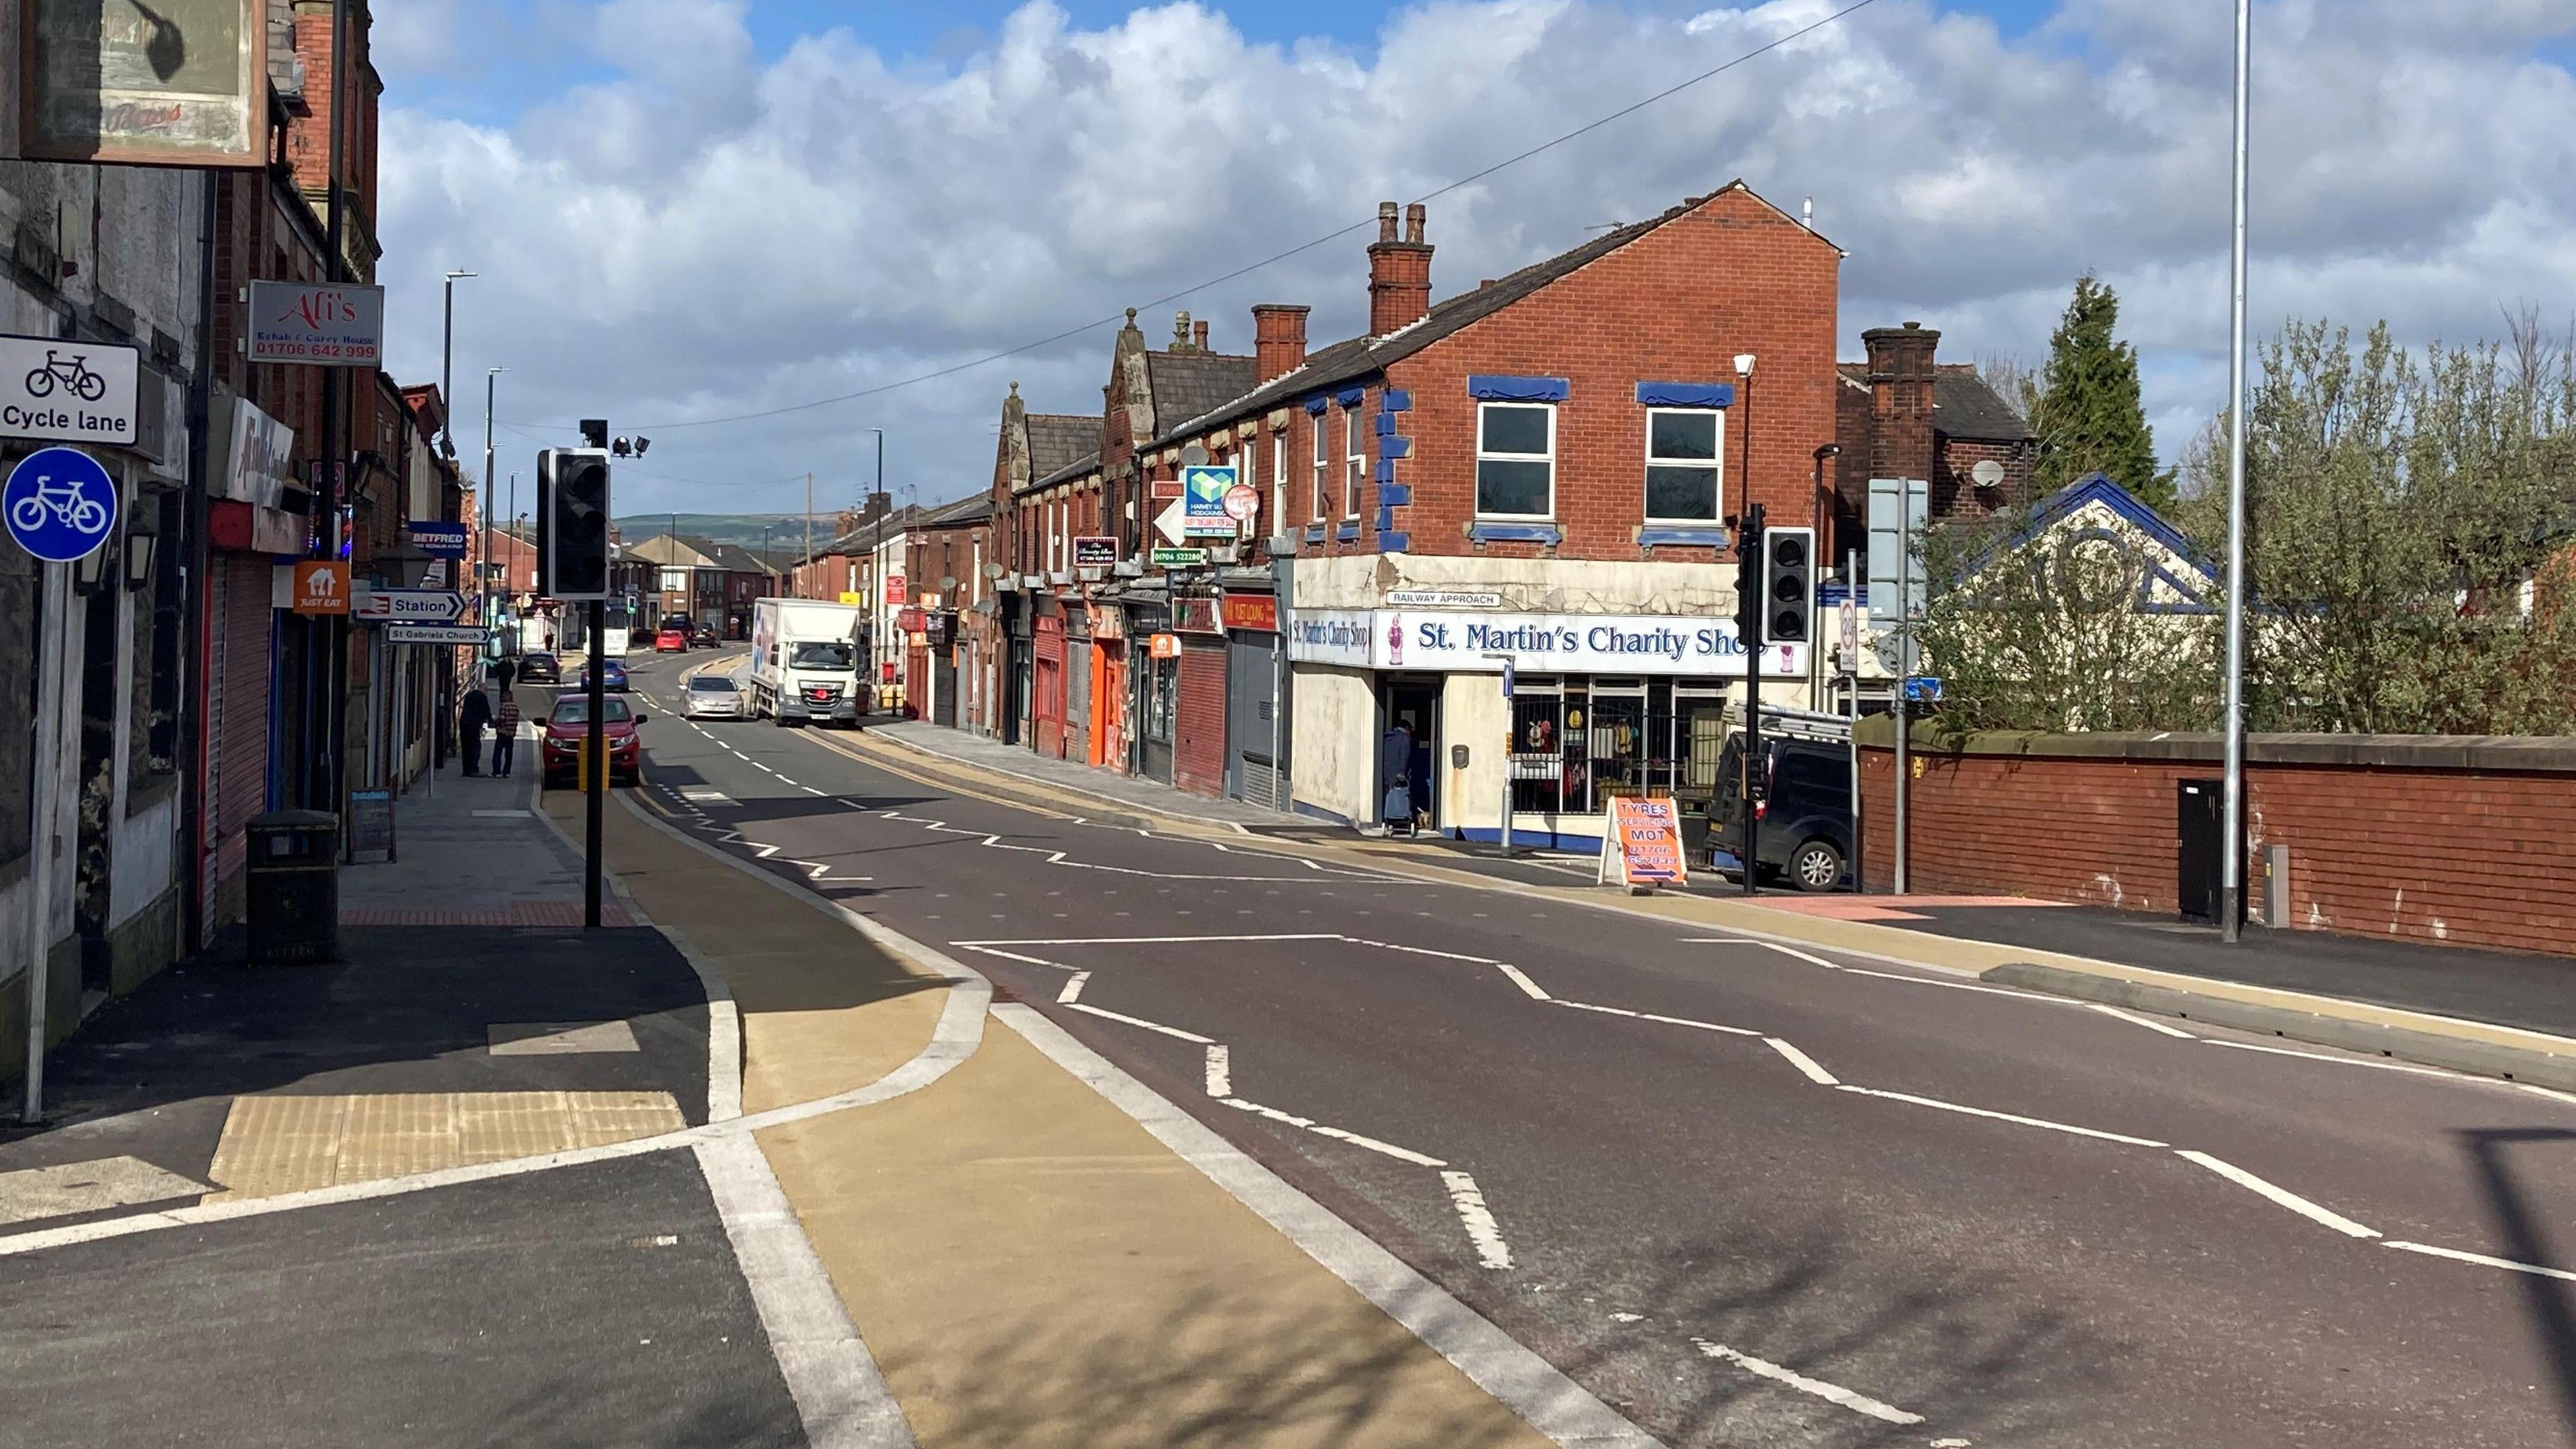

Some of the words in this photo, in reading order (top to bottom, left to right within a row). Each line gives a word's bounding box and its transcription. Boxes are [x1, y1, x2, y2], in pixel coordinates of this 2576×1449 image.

[278, 291, 356, 330] Ali's
[343, 336, 375, 344] House
[256, 341, 305, 355] 01706
[311, 344, 340, 357] 642
[346, 346, 375, 358] 999
[3, 405, 69, 430] Cycle
[78, 411, 126, 431] lane
[413, 533, 464, 543] BETFRED
[301, 598, 321, 607] JUST
[323, 599, 342, 607] EAT
[1394, 593, 1436, 602] RAILWAY
[1440, 594, 1494, 604] APPROACH
[395, 599, 446, 612] Station
[1844, 616, 1853, 636] 20
[406, 630, 444, 639] Gabriels
[446, 631, 480, 639] Church
[1303, 619, 1326, 645] Martin's
[1328, 621, 1350, 651] Charity
[1350, 621, 1368, 654] Shop
[1419, 622, 1456, 651] St.
[1466, 623, 1579, 653] Martin's
[1588, 626, 1689, 661] Charity
[1695, 629, 1769, 657] Sho
[1620, 804, 1668, 814] TYRES
[1620, 818, 1674, 826] SERVICING
[1631, 830, 1665, 841] MOT
[1630, 846, 1672, 854] 01706
